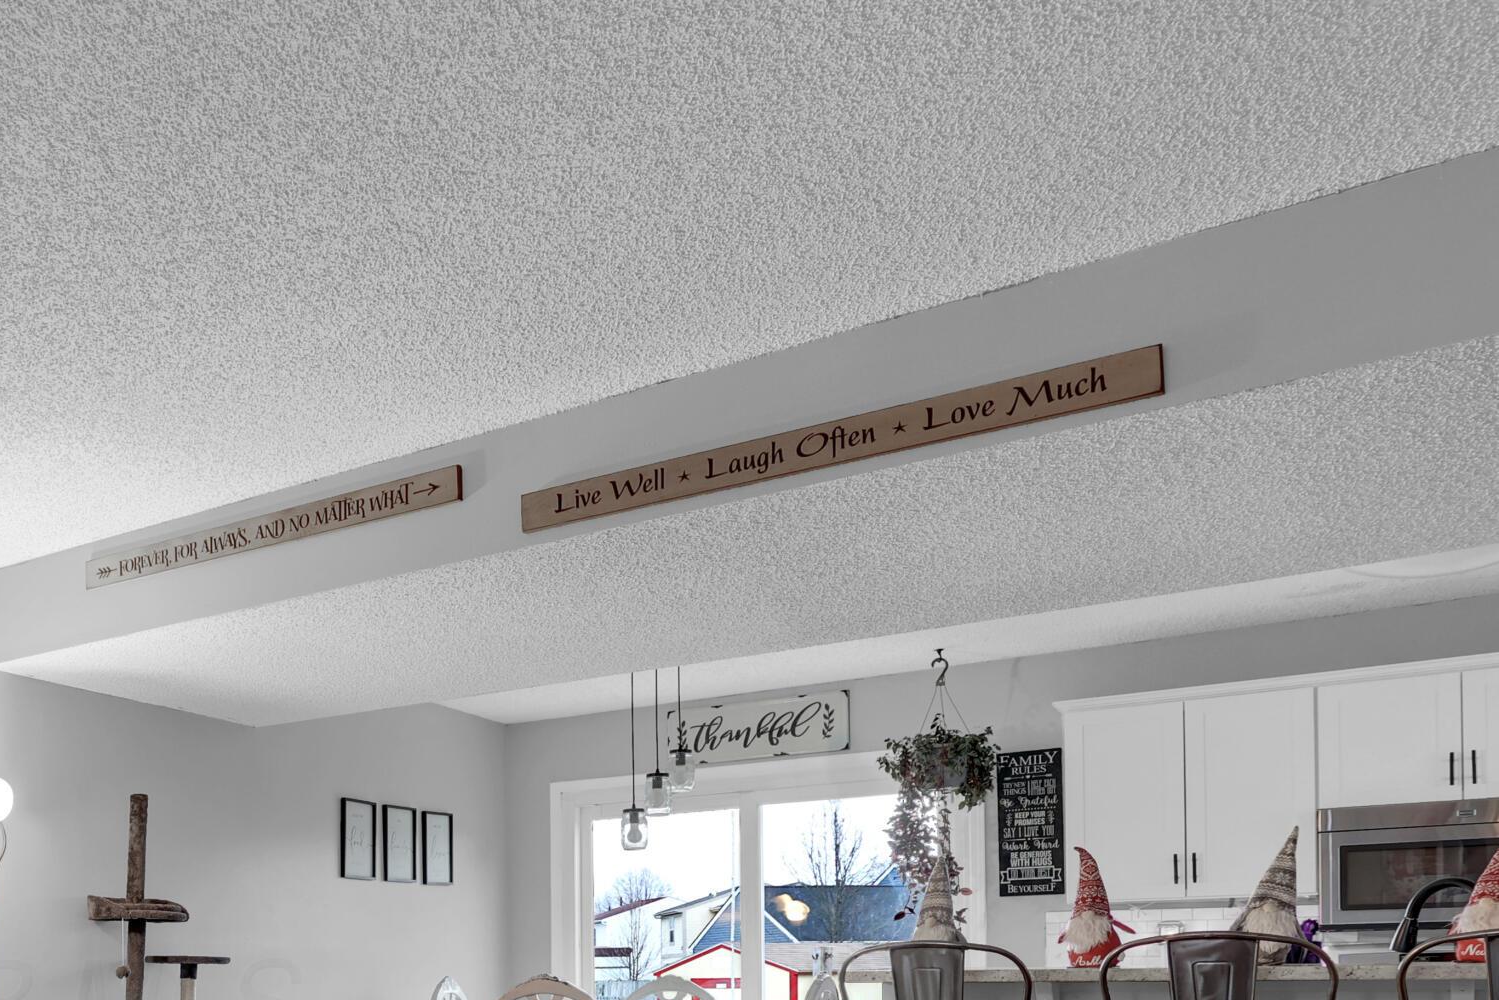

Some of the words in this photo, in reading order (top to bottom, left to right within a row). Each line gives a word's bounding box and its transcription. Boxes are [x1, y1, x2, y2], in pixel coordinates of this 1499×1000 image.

[554, 489, 602, 514] Live
[609, 467, 666, 500] Well
[704, 441, 784, 480] Laugh
[796, 426, 876, 458] Often
[922, 399, 996, 430] Love
[1005, 367, 1108, 417] Much
[173, 541, 198, 562] FOR
[255, 519, 285, 539] AND
[289, 514, 310, 533] NO
[314, 497, 367, 525] MATTER
[369, 482, 414, 512] WHAT
[689, 701, 822, 753] thankful
[999, 750, 1058, 768] FAMILY
[1011, 764, 1047, 776] RULES
[1003, 788, 1027, 796] THINGS
[1017, 794, 1059, 808] Grateful
[1014, 811, 1030, 819] KEEP
[1030, 810, 1046, 818] YOUR
[1014, 817, 1046, 826] PROMISES
[1003, 827, 1016, 839] SAY
[1024, 826, 1039, 837] LOVE
[1041, 825, 1055, 836] YOU
[1001, 841, 1030, 851] Work
[1033, 839, 1060, 850] Hard
[1010, 851, 1019, 859] BE
[1019, 850, 1052, 858] GENEROUS
[1010, 858, 1030, 867] WITH
[1031, 857, 1053, 866] HUGS
[1018, 882, 1056, 893] YOURSELF
[1461, 944, 1486, 956] Ne
